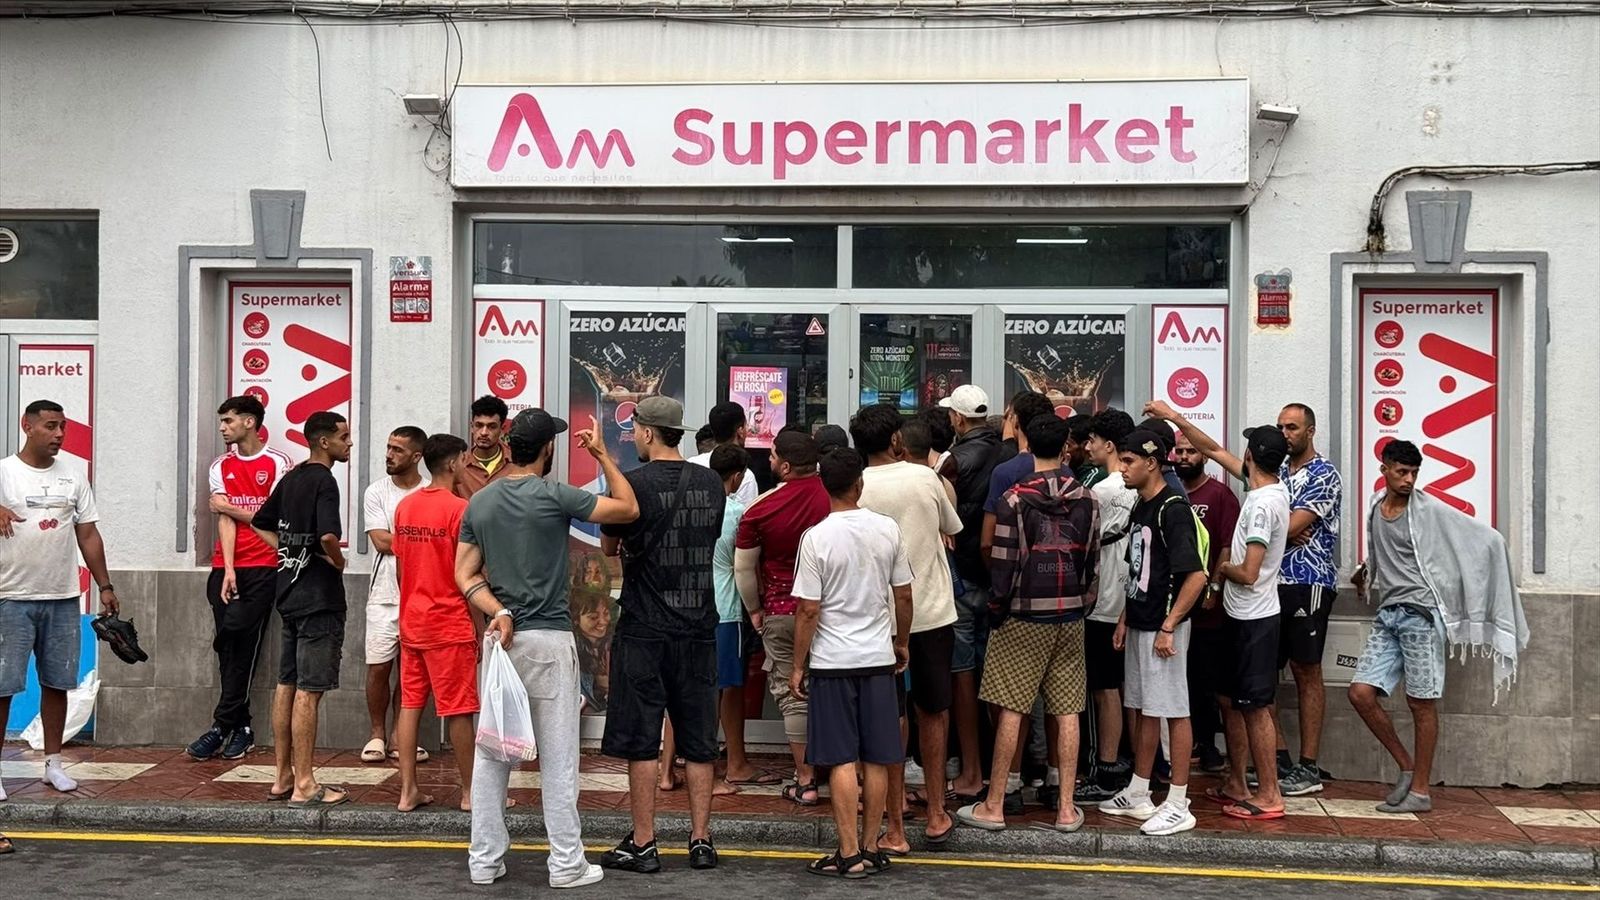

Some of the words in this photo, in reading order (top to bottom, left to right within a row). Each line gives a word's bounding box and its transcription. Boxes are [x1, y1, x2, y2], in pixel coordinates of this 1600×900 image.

[672, 103, 1198, 180] Supermarket
[392, 282, 429, 292] Alarma
[241, 293, 342, 308] Supermarket
[1260, 294, 1287, 302] Alarma
[1372, 301, 1484, 317] Supermarket
[570, 317, 616, 332] ZERO
[618, 312, 686, 332] AZÚCAR
[1004, 319, 1050, 335] ZERO
[1053, 314, 1126, 335] AZÚCAR
[20, 362, 83, 377] market
[508, 403, 532, 411] UTERIA
[1181, 412, 1215, 420] CUTERIA
[686, 490, 711, 508] ARE
[660, 547, 684, 566] AND
[687, 546, 711, 565] THE
[664, 589, 704, 608] HEART
